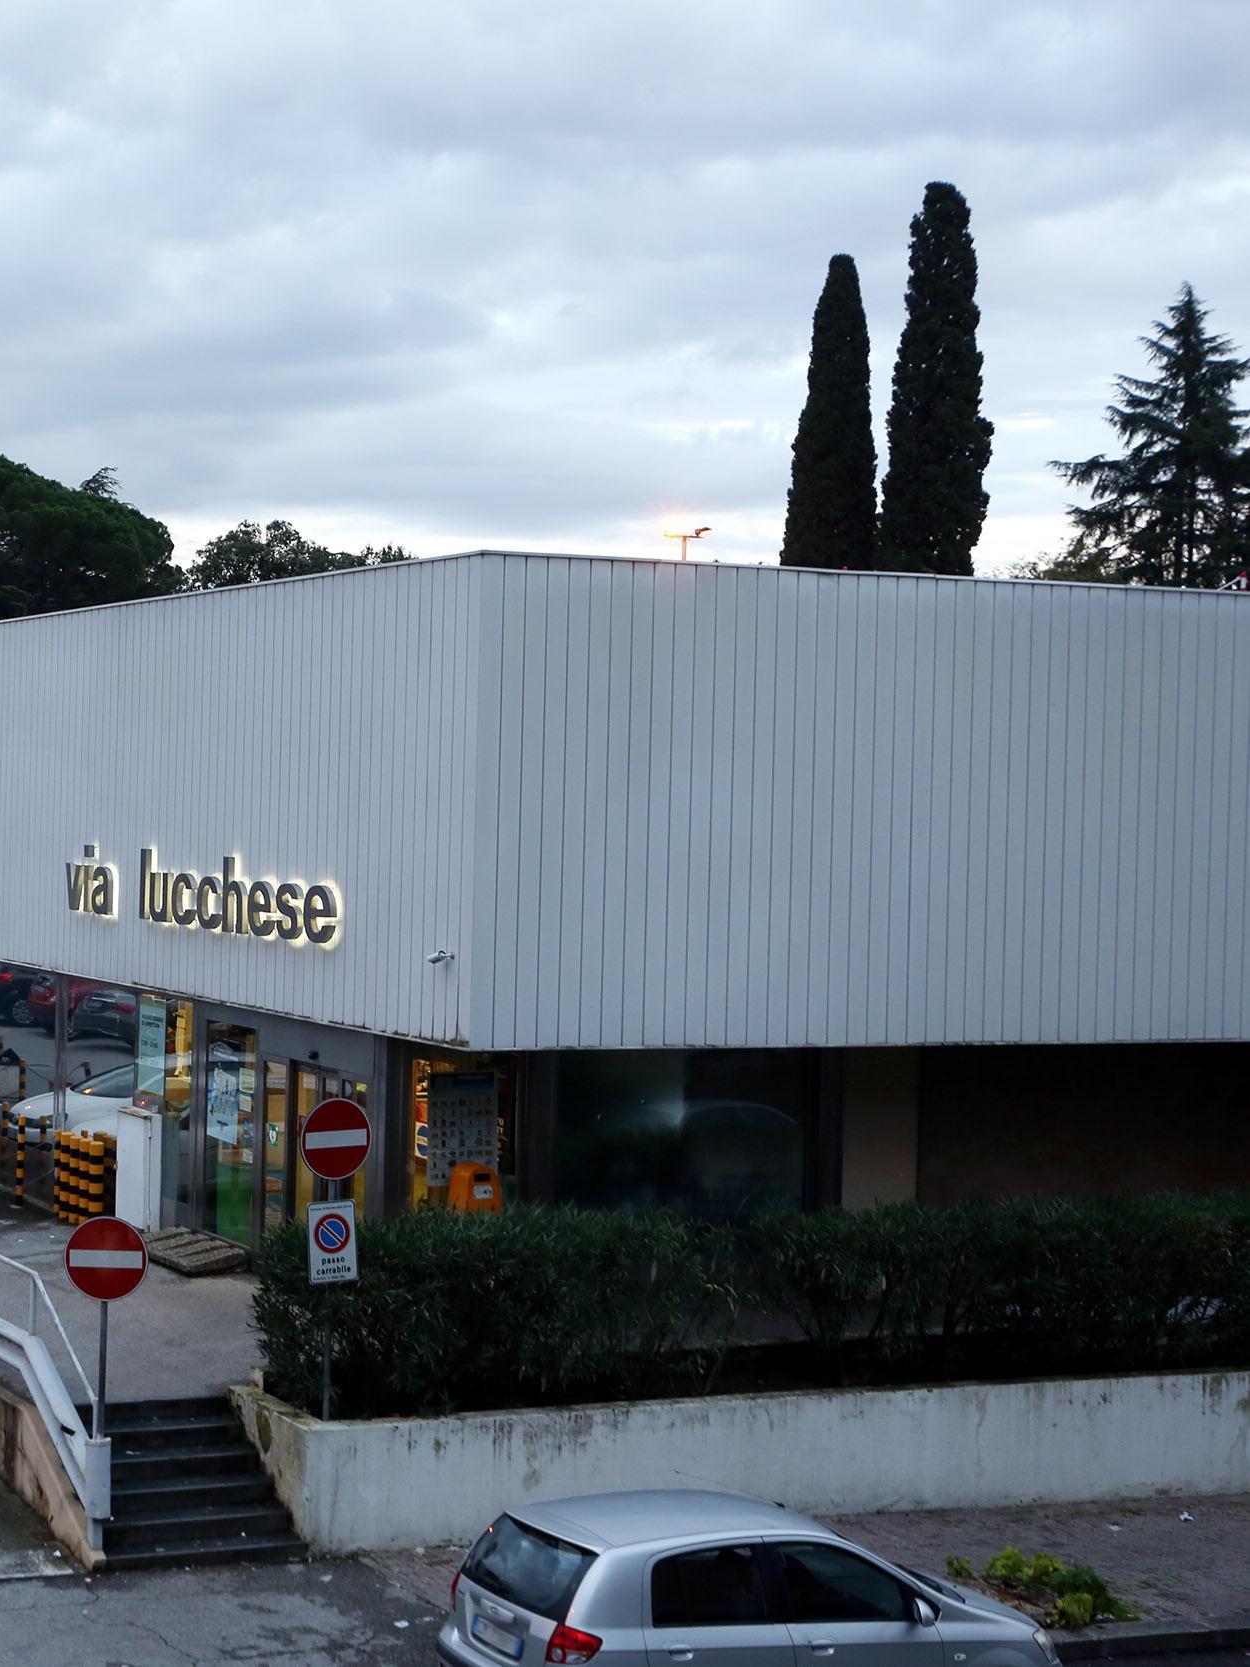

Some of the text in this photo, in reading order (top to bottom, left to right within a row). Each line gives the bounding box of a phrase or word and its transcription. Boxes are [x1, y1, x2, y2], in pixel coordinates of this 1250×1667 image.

[65, 844, 338, 944] via lucchese
[321, 1256, 346, 1266] passo
[316, 1265, 352, 1276] carrabile
